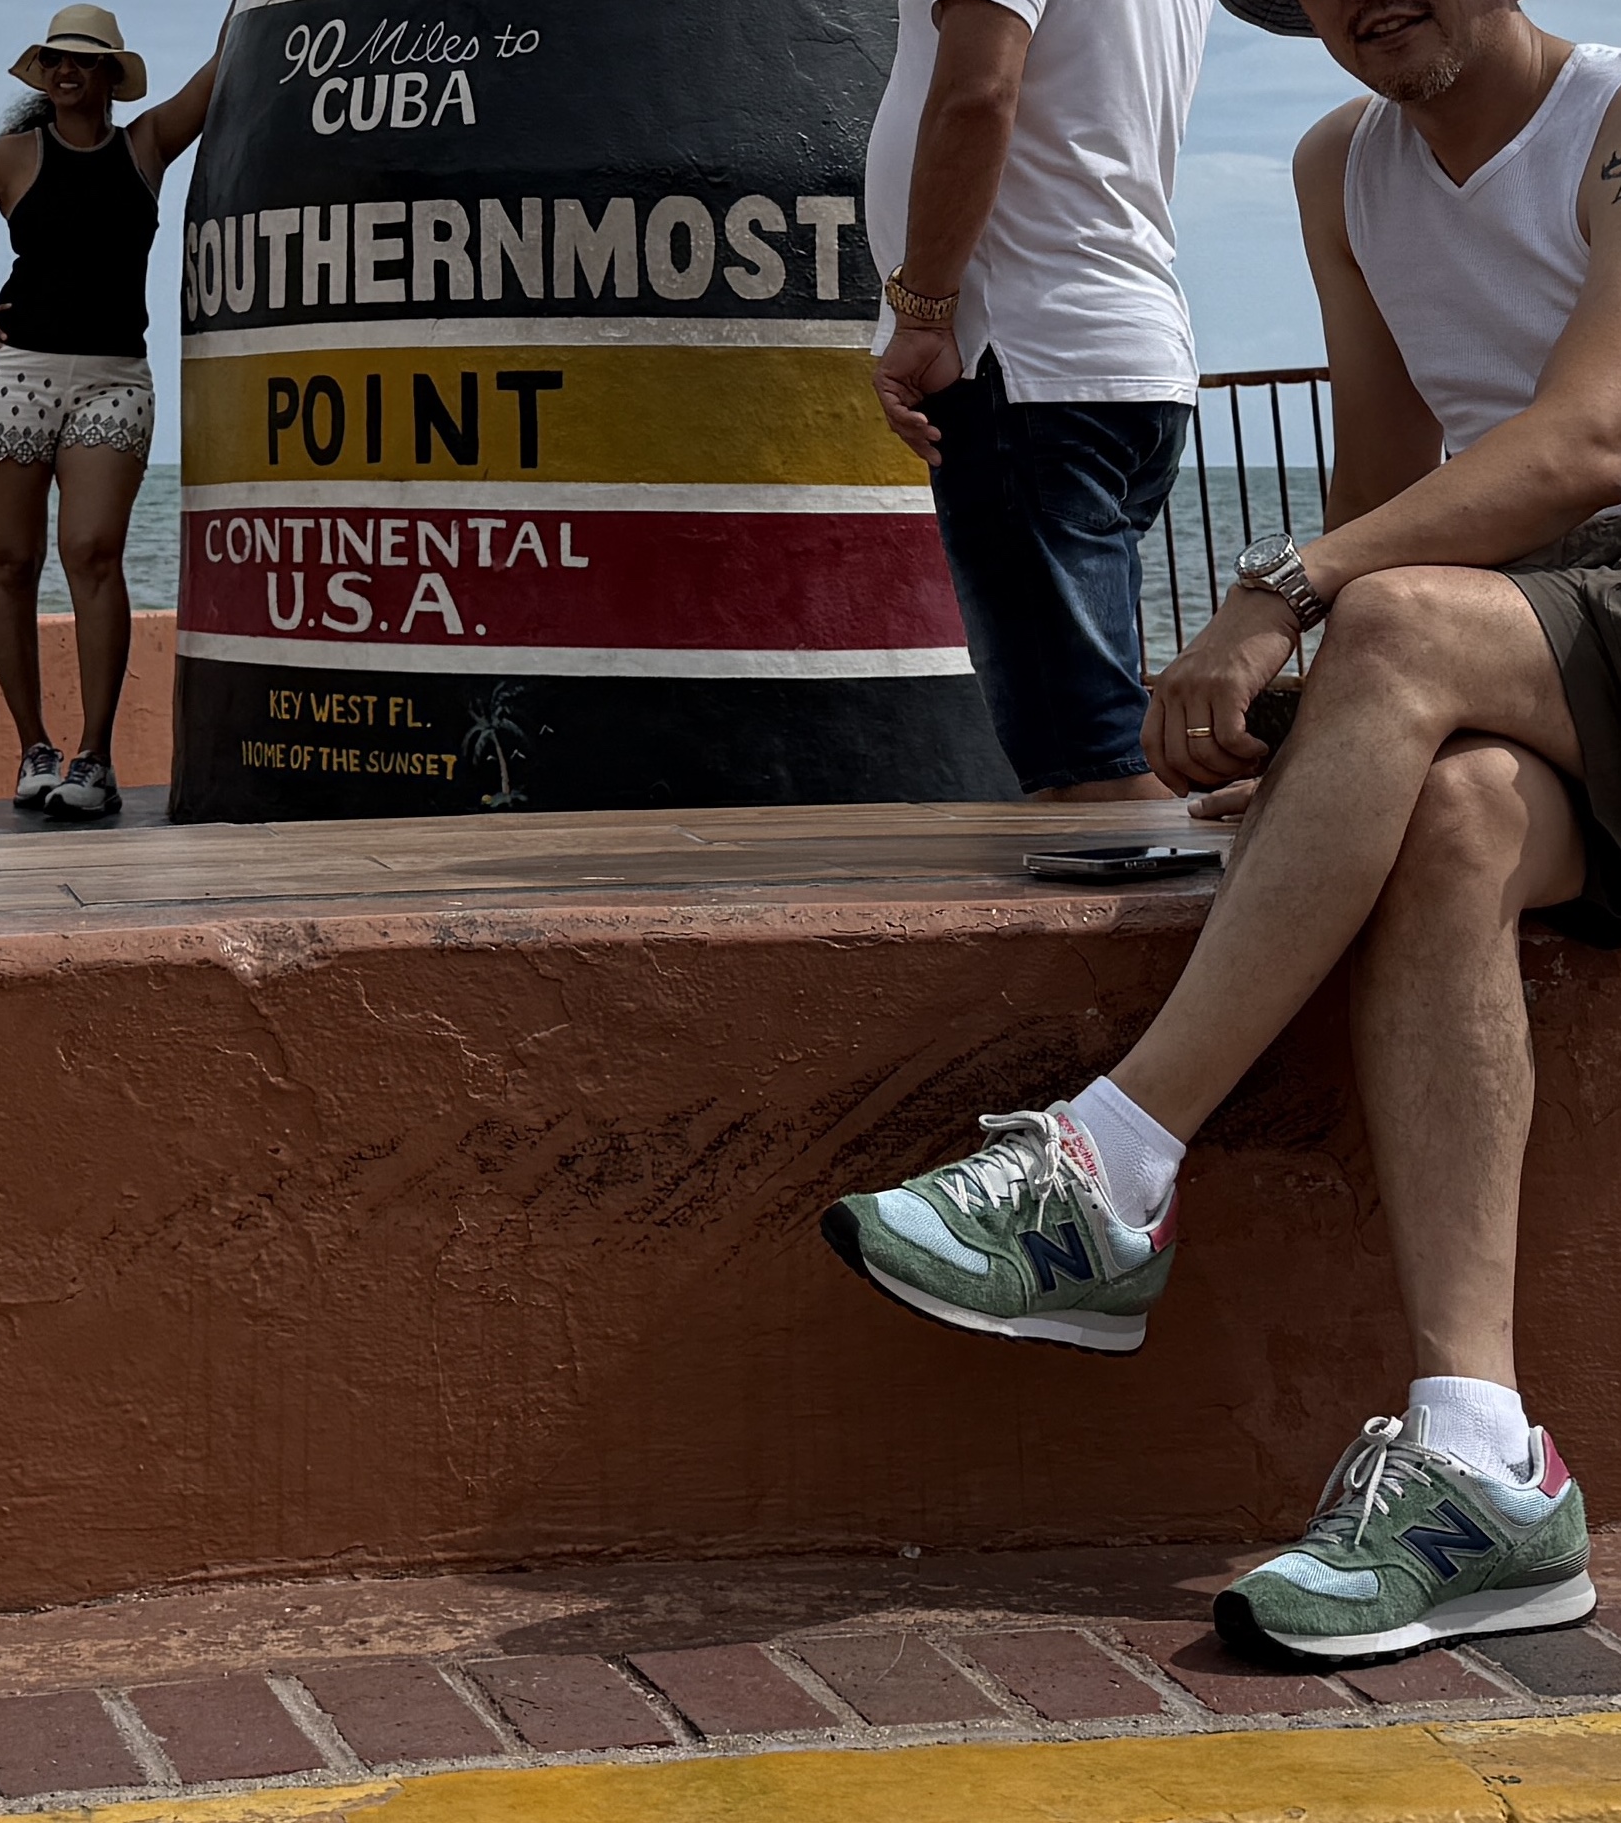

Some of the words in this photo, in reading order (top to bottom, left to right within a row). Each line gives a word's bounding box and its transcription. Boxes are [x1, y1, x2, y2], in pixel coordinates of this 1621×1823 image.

[279, 18, 347, 84] 90
[337, 18, 480, 68] Miles
[493, 24, 540, 58] to
[311, 69, 476, 135] CUBA
[186, 195, 856, 322] SOUTHERNMOST
[267, 370, 564, 469] POINT
[205, 517, 590, 568] CONTINENTAL
[266, 571, 487, 636] U.S.A.
[269, 689, 303, 720] KEY
[310, 692, 378, 726] WEST
[388, 696, 432, 728] FL.
[241, 740, 286, 768] HOME
[290, 744, 315, 771] OF
[318, 746, 361, 773] THE
[365, 750, 458, 780] SUNSET
[1015, 1221, 1095, 1294] N
[1392, 1498, 1497, 1585] N
